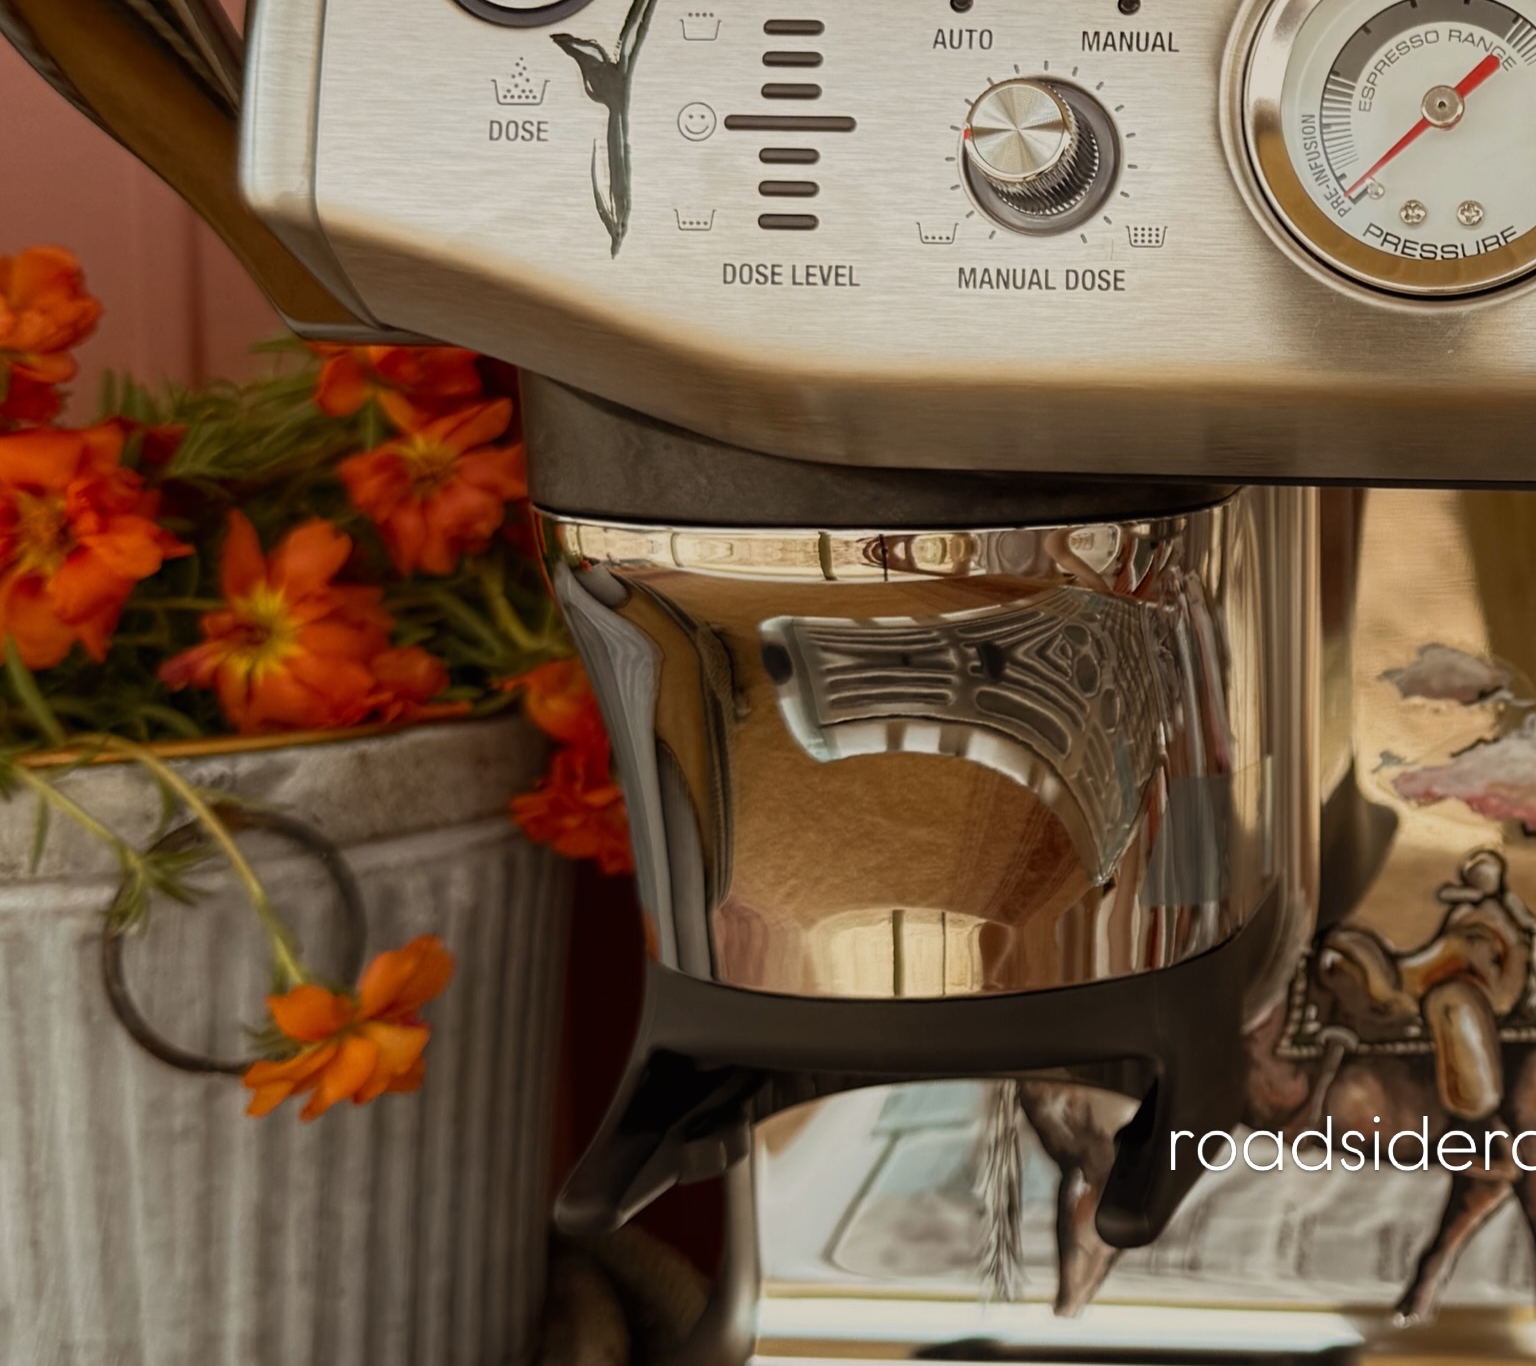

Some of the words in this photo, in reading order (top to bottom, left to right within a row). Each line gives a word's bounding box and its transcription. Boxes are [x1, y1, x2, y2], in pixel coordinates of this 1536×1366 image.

[932, 28, 994, 51] AUTO
[1081, 30, 1180, 53] MANUAL
[1358, 29, 1440, 112] ESPRESSO
[1448, 29, 1517, 71] RANGE
[488, 119, 549, 142] DOSE
[1301, 114, 1352, 218] PRE-INFUSION
[1362, 222, 1518, 261] PRESSURE
[722, 262, 784, 286] DOSE
[791, 264, 861, 287] LEVEL
[957, 266, 1057, 291] MANUAL
[1065, 268, 1126, 292] DOSE
